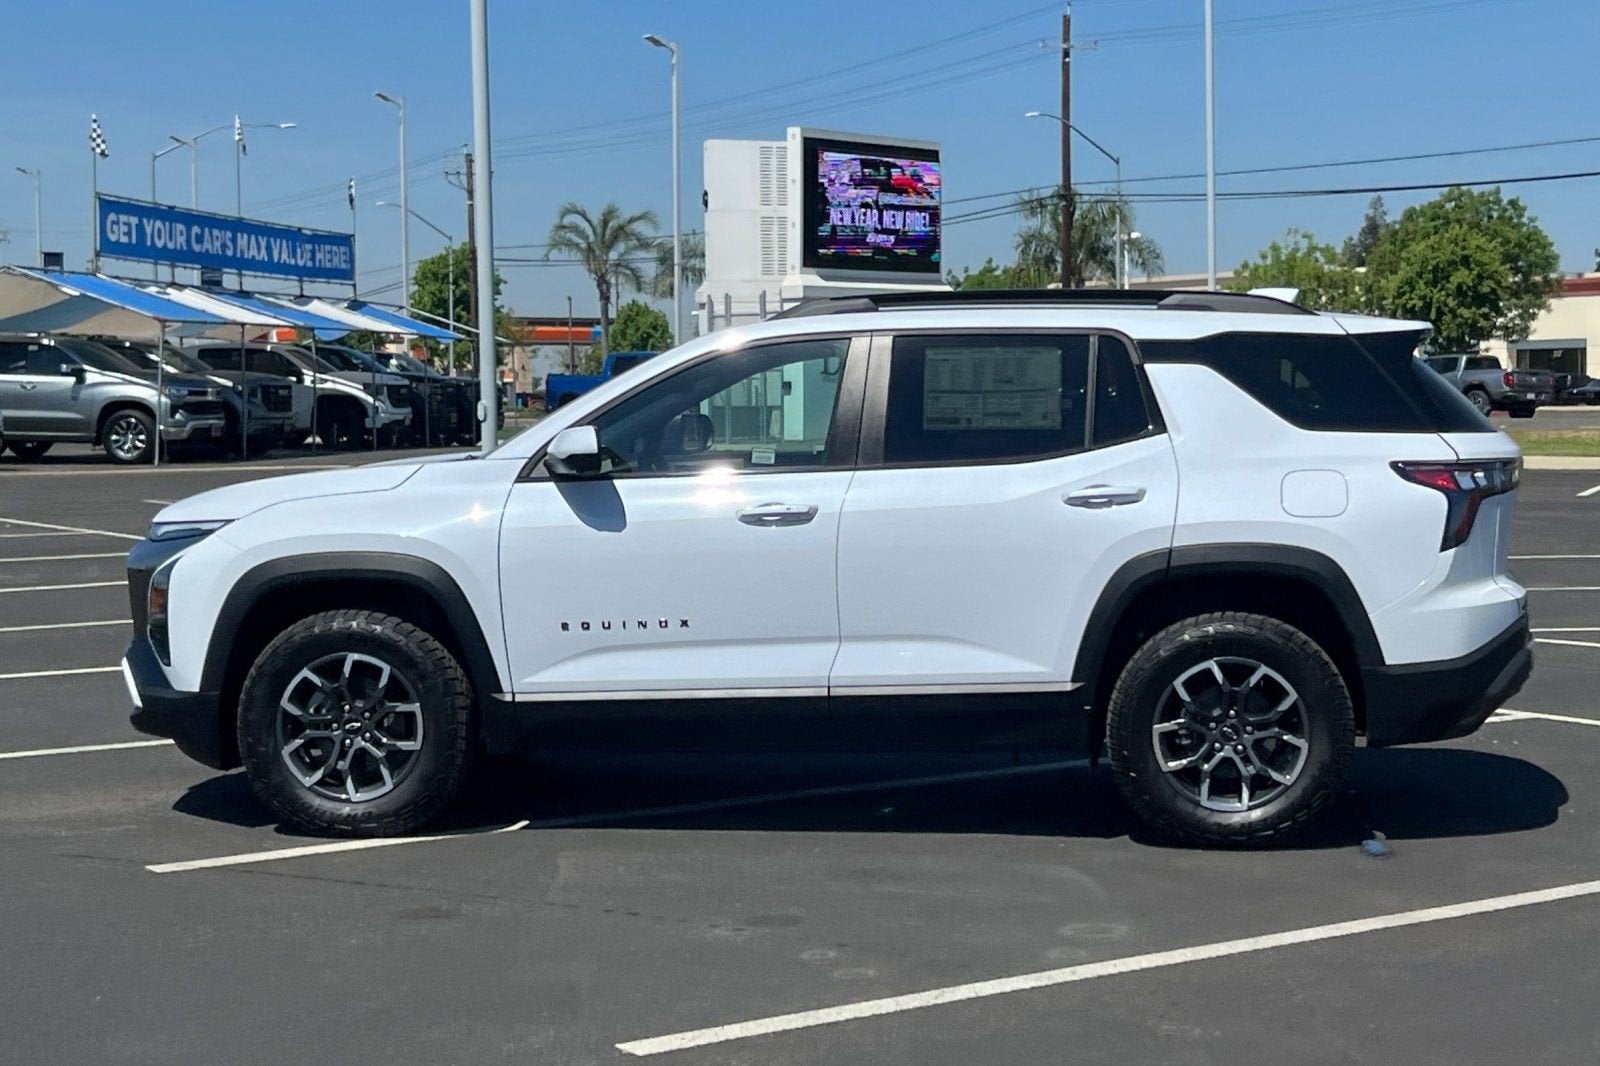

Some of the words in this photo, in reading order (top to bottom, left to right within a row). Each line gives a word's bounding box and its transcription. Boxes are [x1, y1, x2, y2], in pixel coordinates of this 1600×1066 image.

[829, 207, 852, 226] NEW
[883, 209, 904, 230] NEW
[106, 212, 139, 244] GET
[144, 218, 187, 251] YOUR
[190, 225, 233, 257] CAR'S
[237, 232, 268, 262] MAX
[270, 238, 313, 267] VALUE
[315, 244, 351, 270] HERE!
[561, 619, 690, 631] EQUINOX
